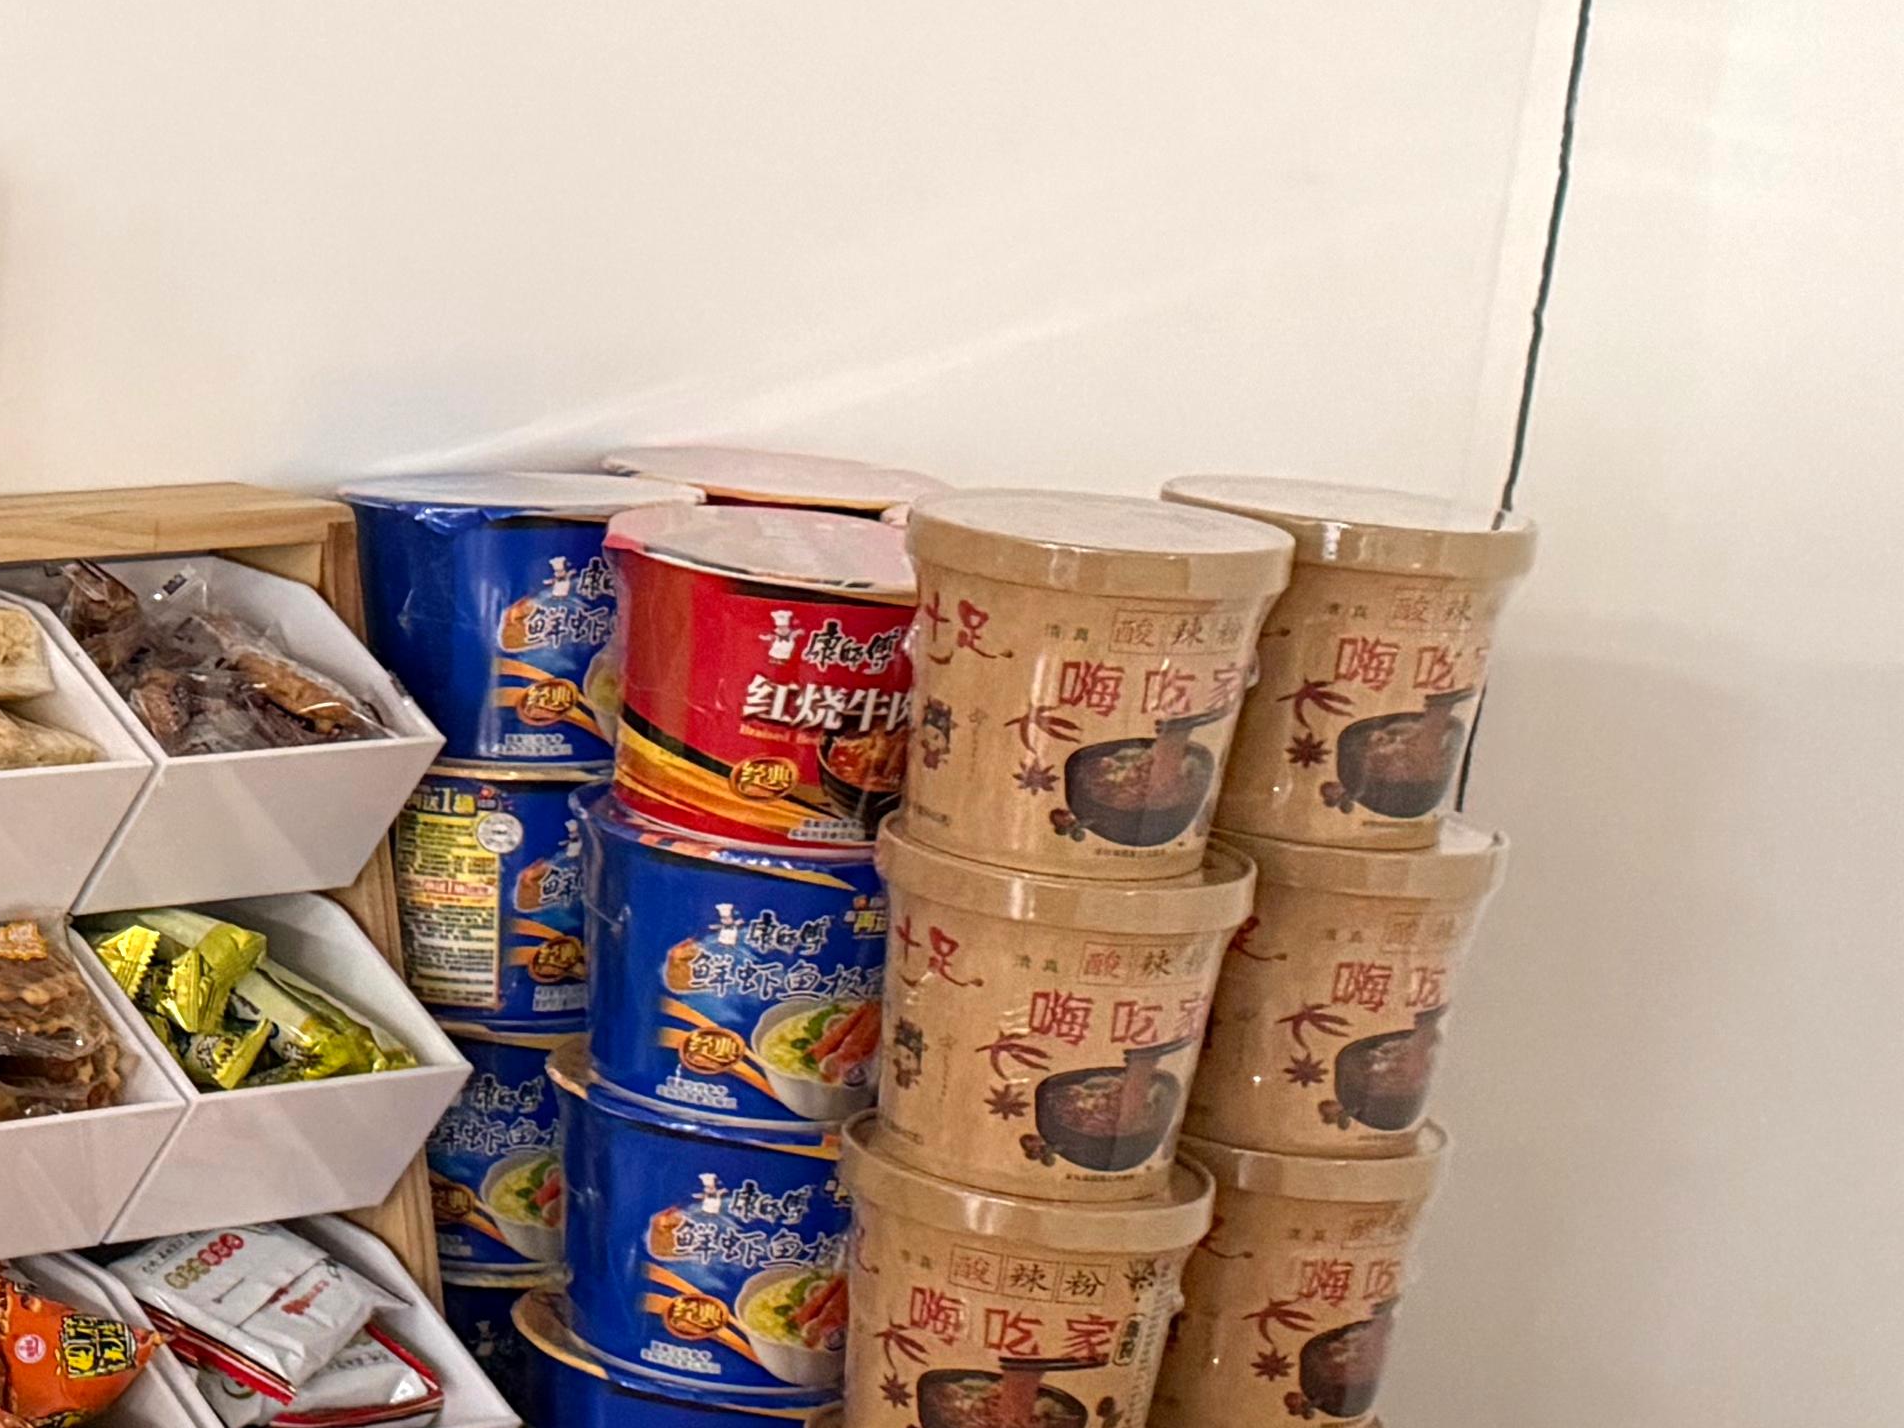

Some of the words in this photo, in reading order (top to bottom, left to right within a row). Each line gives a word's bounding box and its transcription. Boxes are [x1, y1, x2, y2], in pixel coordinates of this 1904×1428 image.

[1334, 636, 1490, 692] 嗨吃
[739, 762, 790, 785] 经典
[689, 1031, 739, 1059] 经典
[953, 1254, 1105, 1298] 酸辣粉
[671, 1297, 721, 1321] 经典
[910, 1286, 1120, 1363] 嗨吃家
